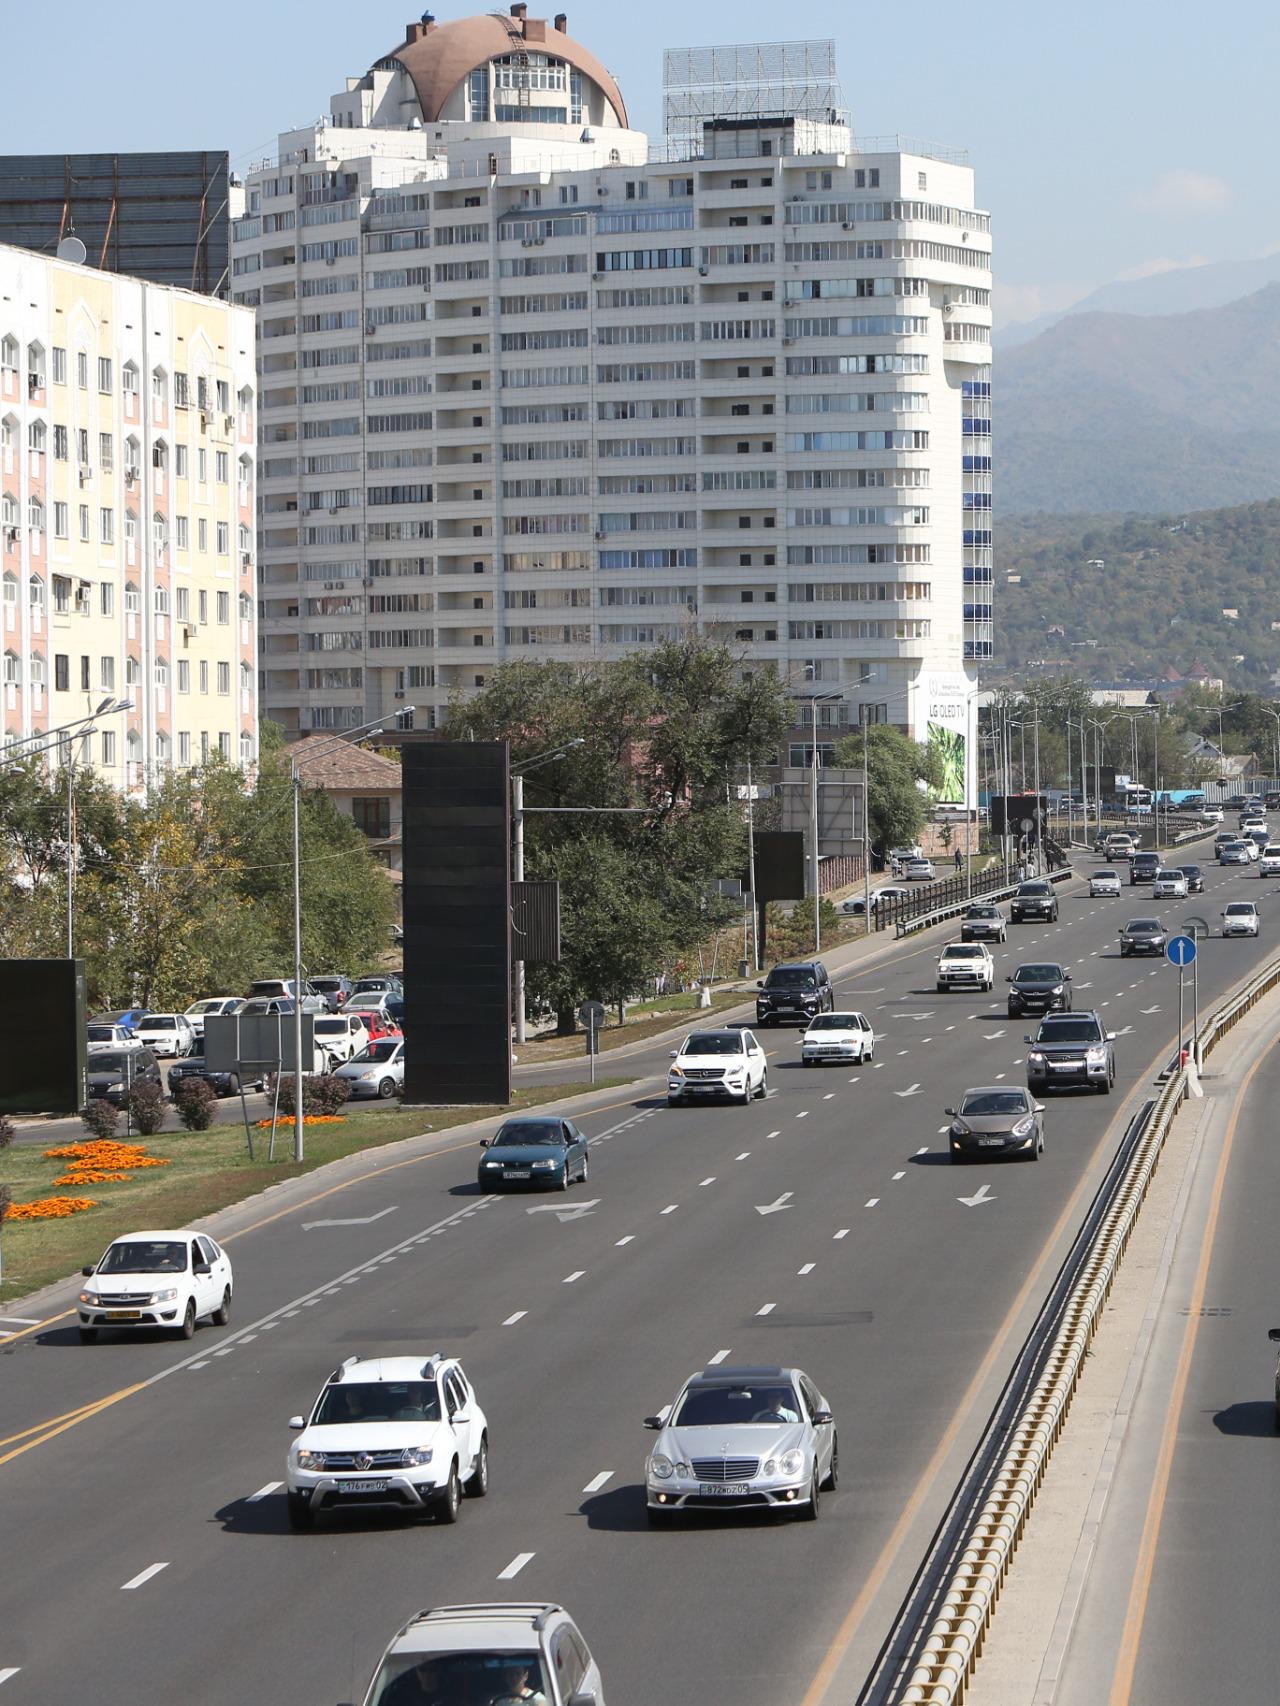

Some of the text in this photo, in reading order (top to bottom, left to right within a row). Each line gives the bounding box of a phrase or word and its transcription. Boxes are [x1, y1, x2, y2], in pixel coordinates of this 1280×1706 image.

[930, 704, 964, 718] LG OLED TV
